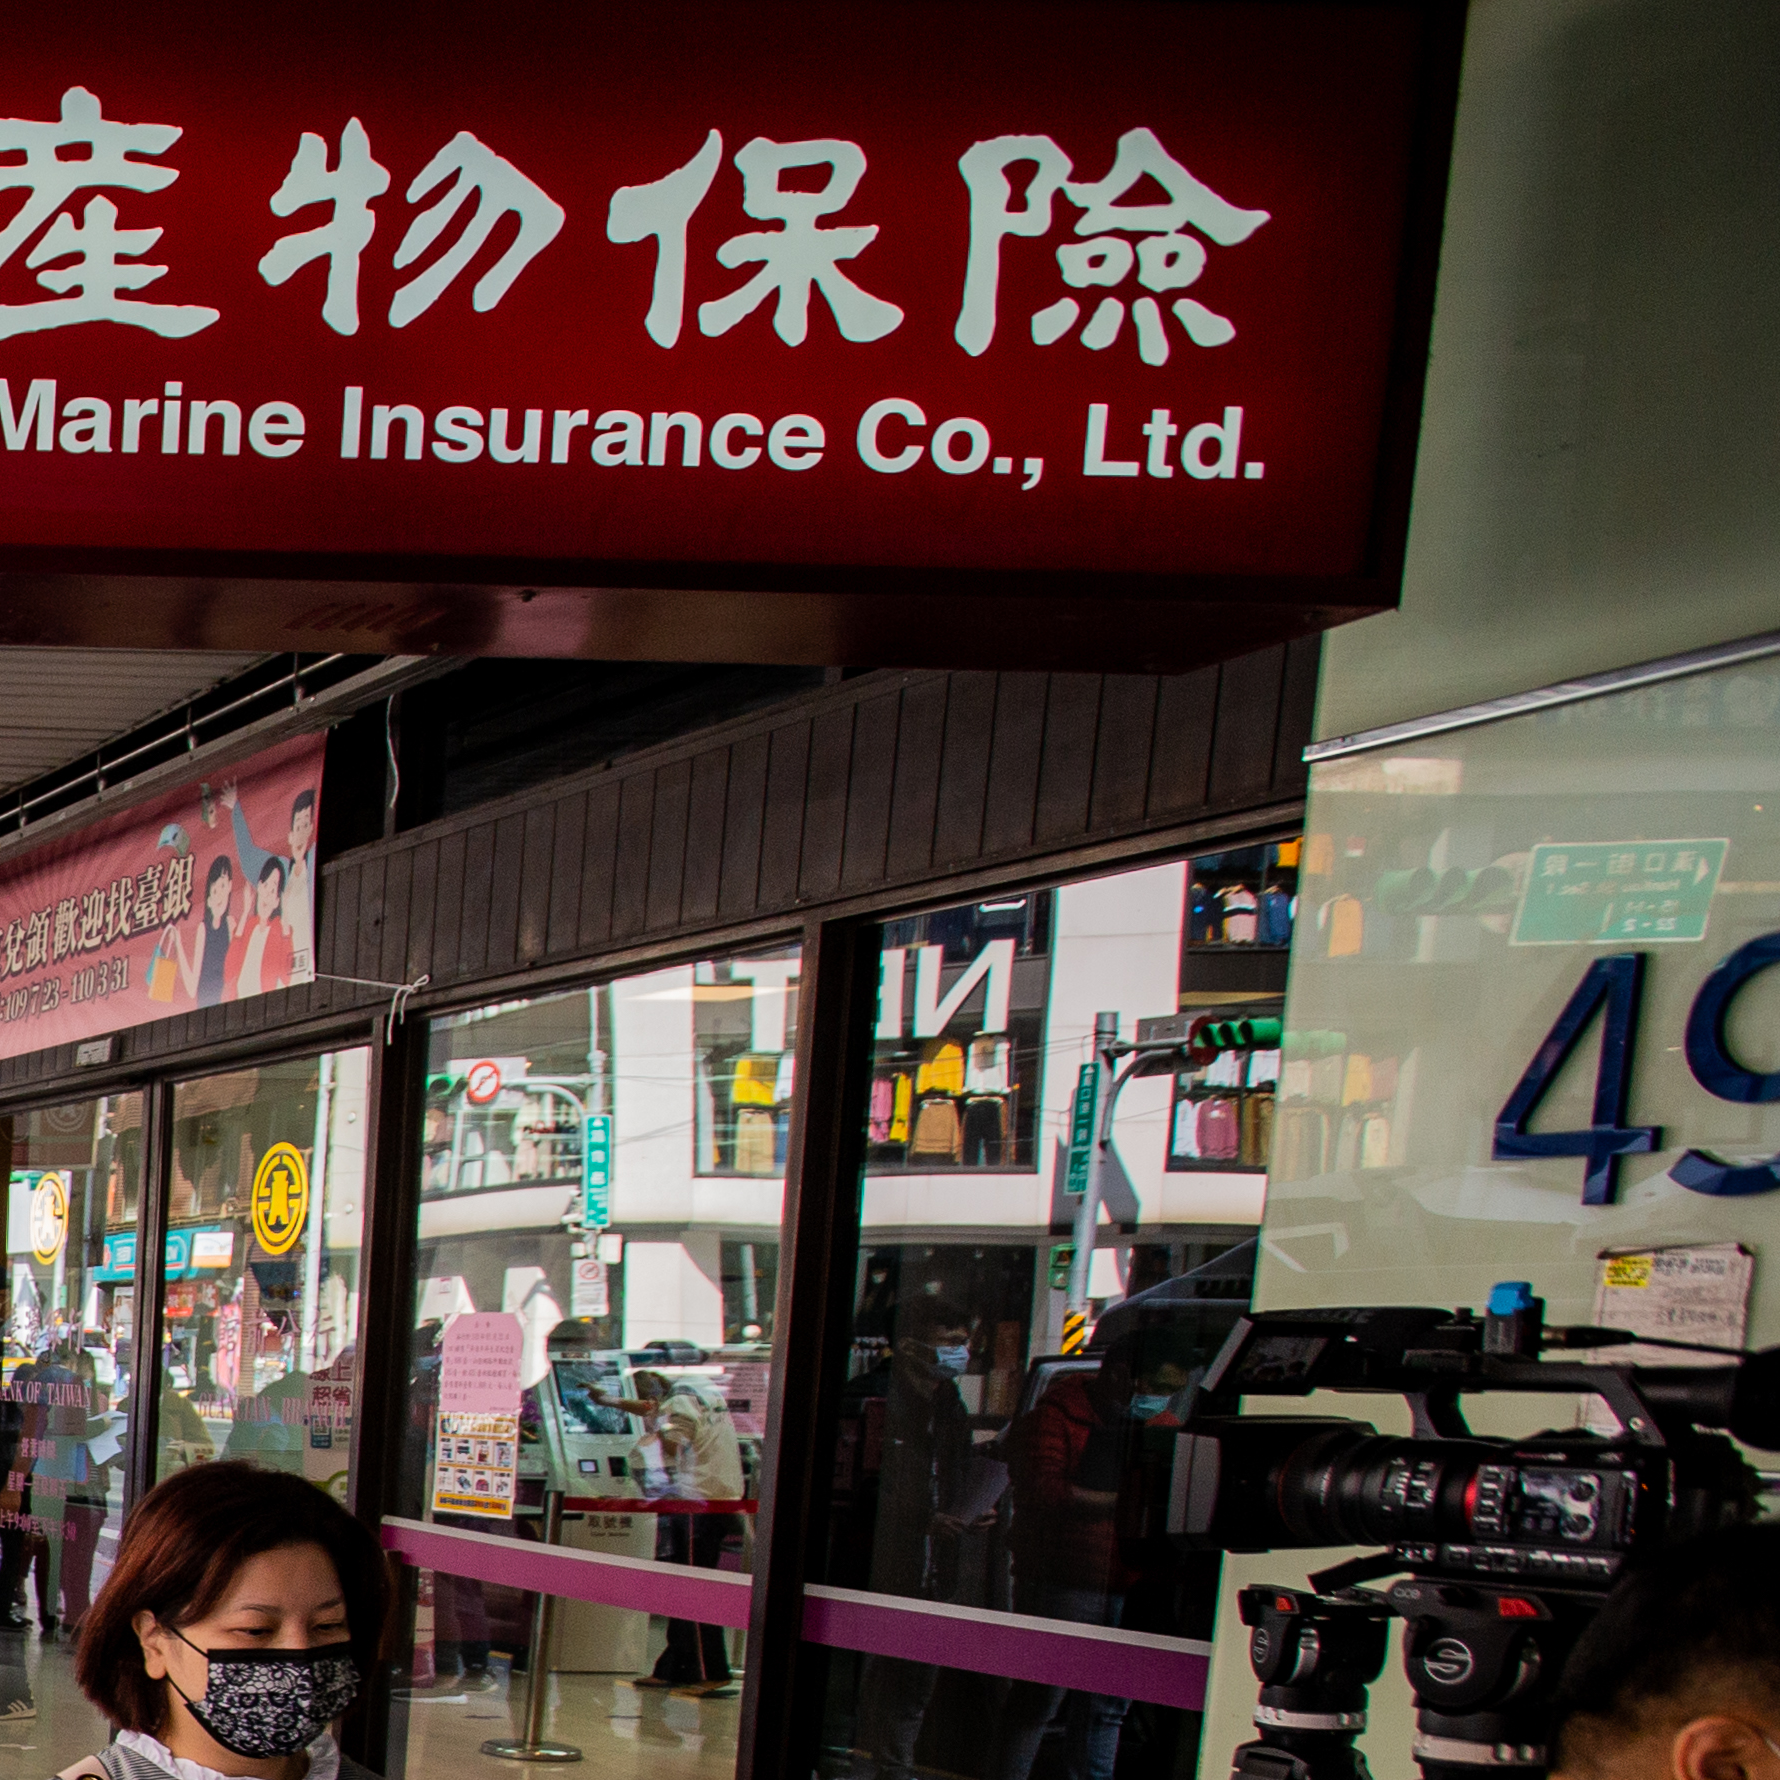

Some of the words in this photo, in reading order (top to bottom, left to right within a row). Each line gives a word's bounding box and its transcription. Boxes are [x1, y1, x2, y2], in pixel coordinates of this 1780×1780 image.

[339, 386, 826, 474] Insurance
[853, 397, 1045, 492] Co.,
[1082, 403, 1268, 483] Ltd.
